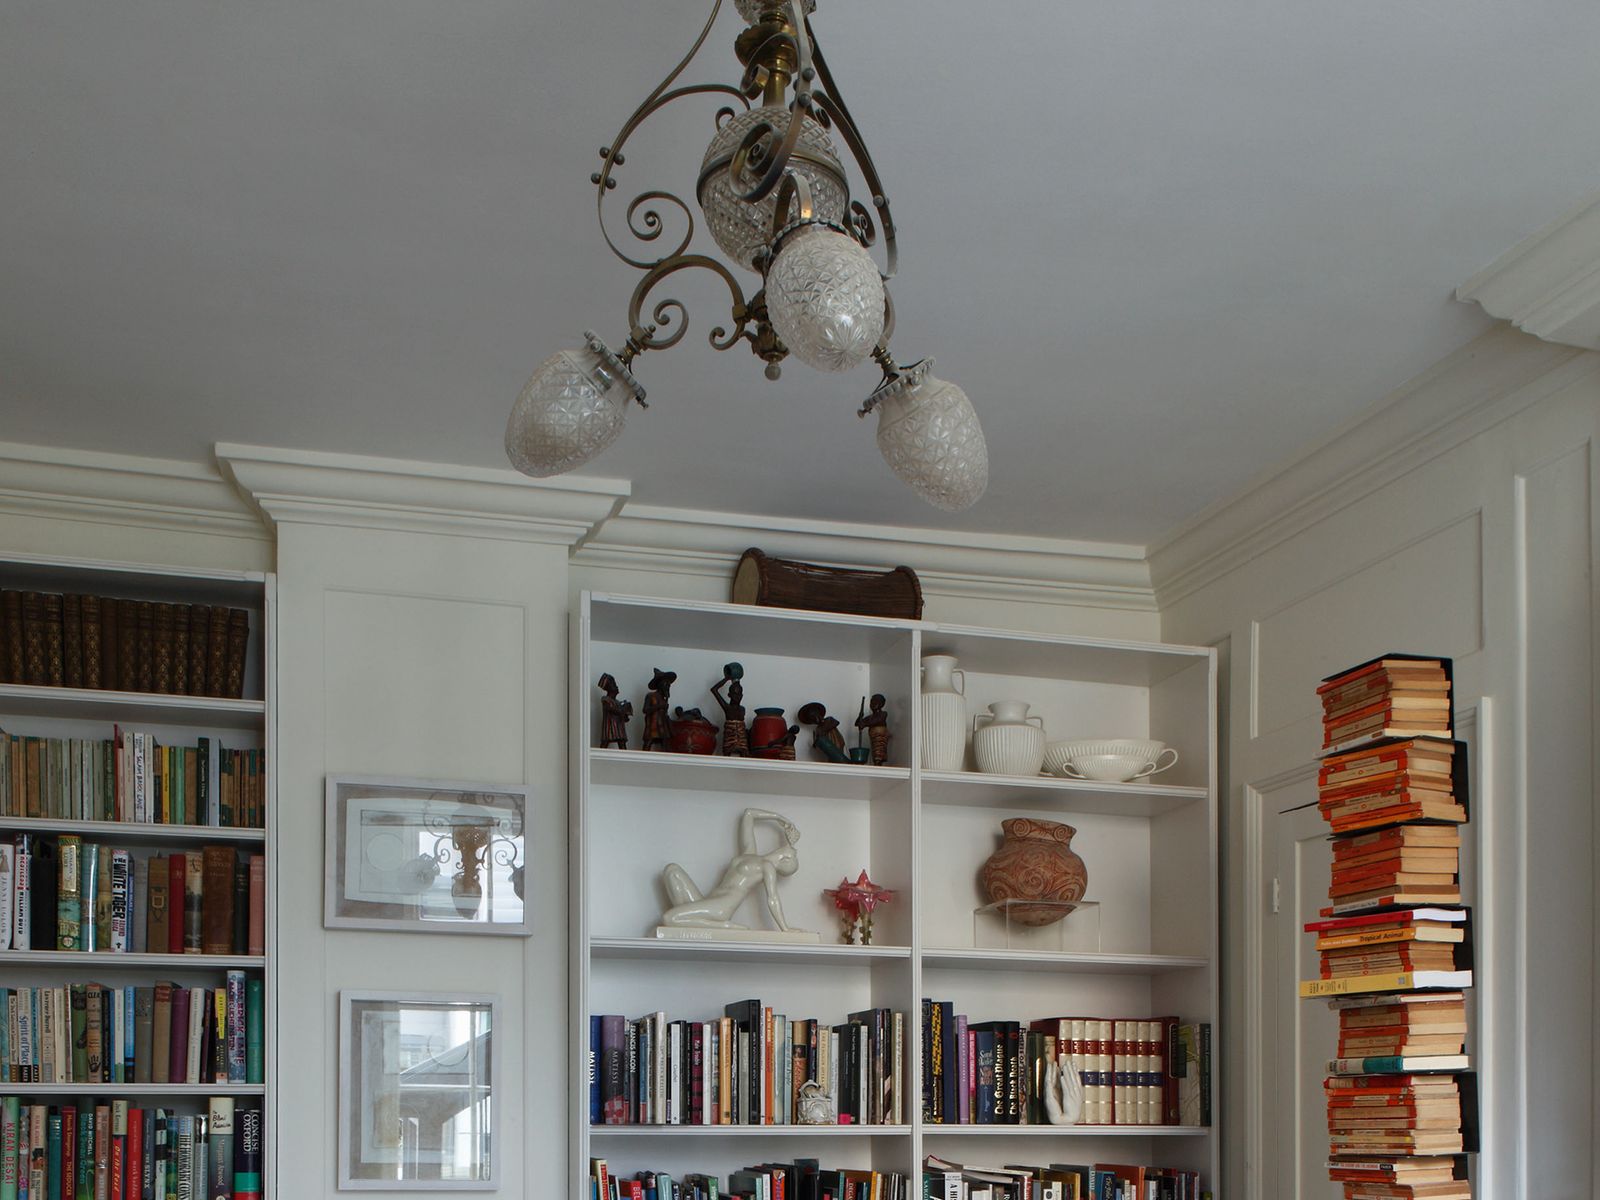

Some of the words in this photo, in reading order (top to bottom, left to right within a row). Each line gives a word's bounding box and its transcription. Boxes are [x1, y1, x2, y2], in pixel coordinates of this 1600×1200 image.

[113, 863, 126, 889] WHITE
[112, 891, 126, 919] TIGER
[1359, 933, 1382, 942] Tropical
[1383, 931, 1404, 939] Animal
[19, 1016, 28, 1035] Spirit
[21, 1045, 30, 1064] Place
[994, 1044, 1005, 1072] Plague
[1009, 1056, 1017, 1077] Death
[994, 1074, 1004, 1098] Great
[1009, 1079, 1017, 1099] Black
[994, 1101, 1004, 1115] The
[1009, 1101, 1018, 1115] The
[6, 1122, 15, 1151] KIRAN
[179, 1135, 191, 1146] THE
[243, 1114, 251, 1151] OXFORD
[115, 1145, 121, 1154] On
[6, 1157, 15, 1184] DESAI
[217, 1164, 225, 1185] Atwood
